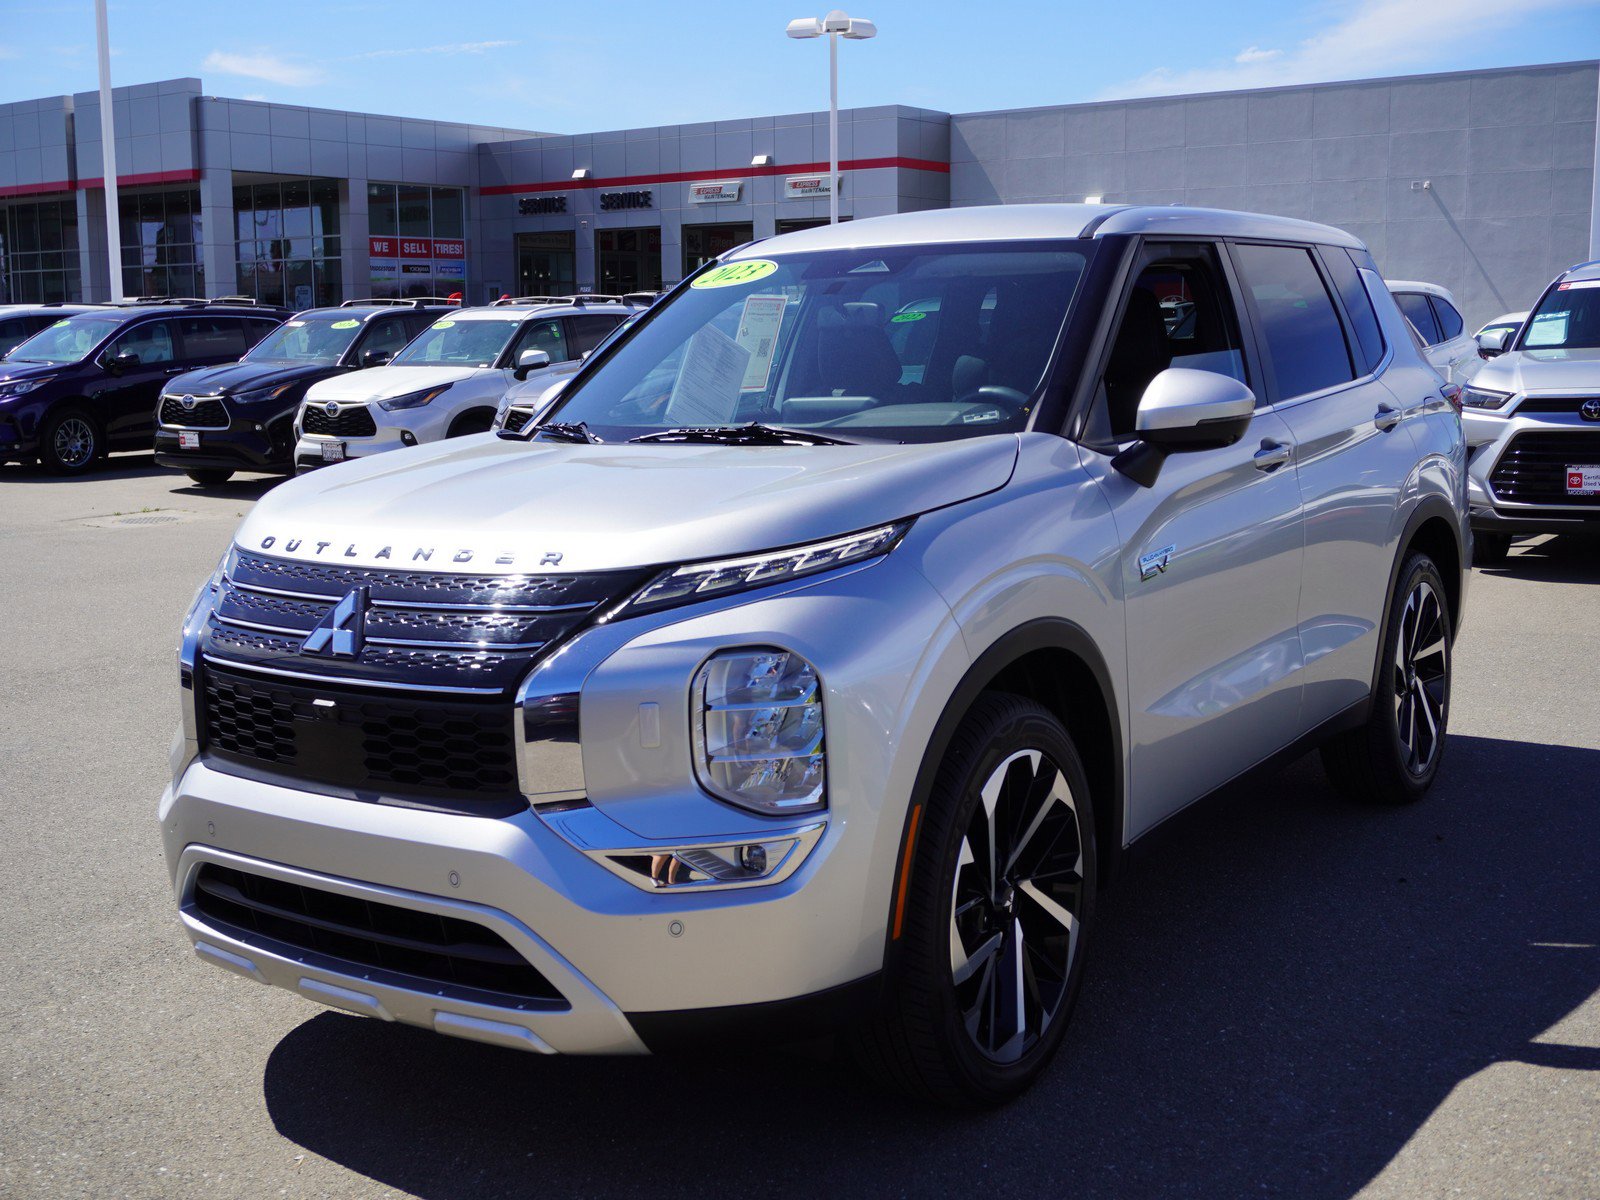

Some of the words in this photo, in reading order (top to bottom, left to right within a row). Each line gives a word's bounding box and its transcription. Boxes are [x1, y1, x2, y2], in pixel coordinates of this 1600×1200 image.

[600, 191, 652, 210] SERVICE
[700, 187, 721, 195] EXPRESS
[518, 196, 567, 215] SERVICE
[373, 241, 389, 253] WE
[403, 242, 427, 254] SELL
[434, 243, 463, 255] TIRES!
[698, 263, 768, 284] 2023
[260, 535, 564, 566] OUTLANDER
